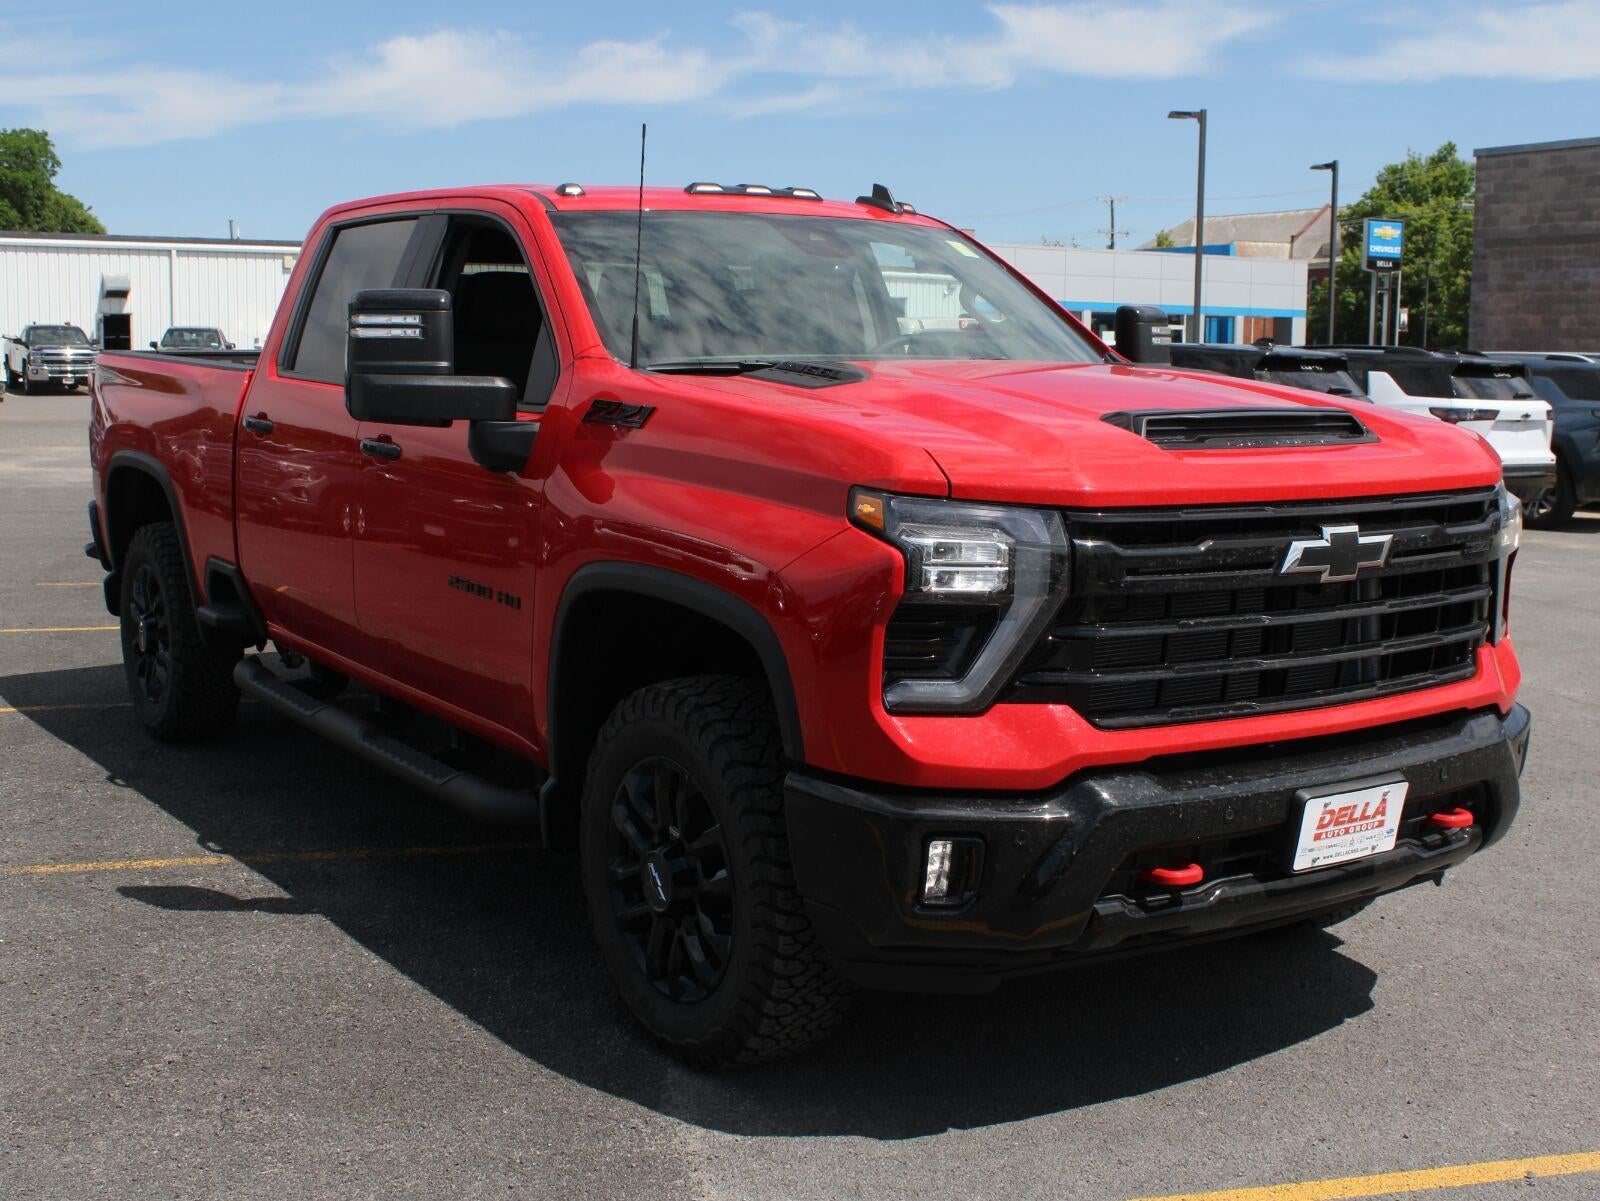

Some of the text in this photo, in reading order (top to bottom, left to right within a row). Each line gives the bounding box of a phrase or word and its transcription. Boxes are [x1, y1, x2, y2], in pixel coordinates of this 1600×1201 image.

[1370, 244, 1401, 254] CHEVROLET
[1376, 260, 1393, 268] DELLA
[581, 398, 657, 428] Z71
[448, 573, 493, 600] 2500
[1316, 798, 1387, 830] DELLA
[1320, 821, 1379, 840] AUTO GROUP
